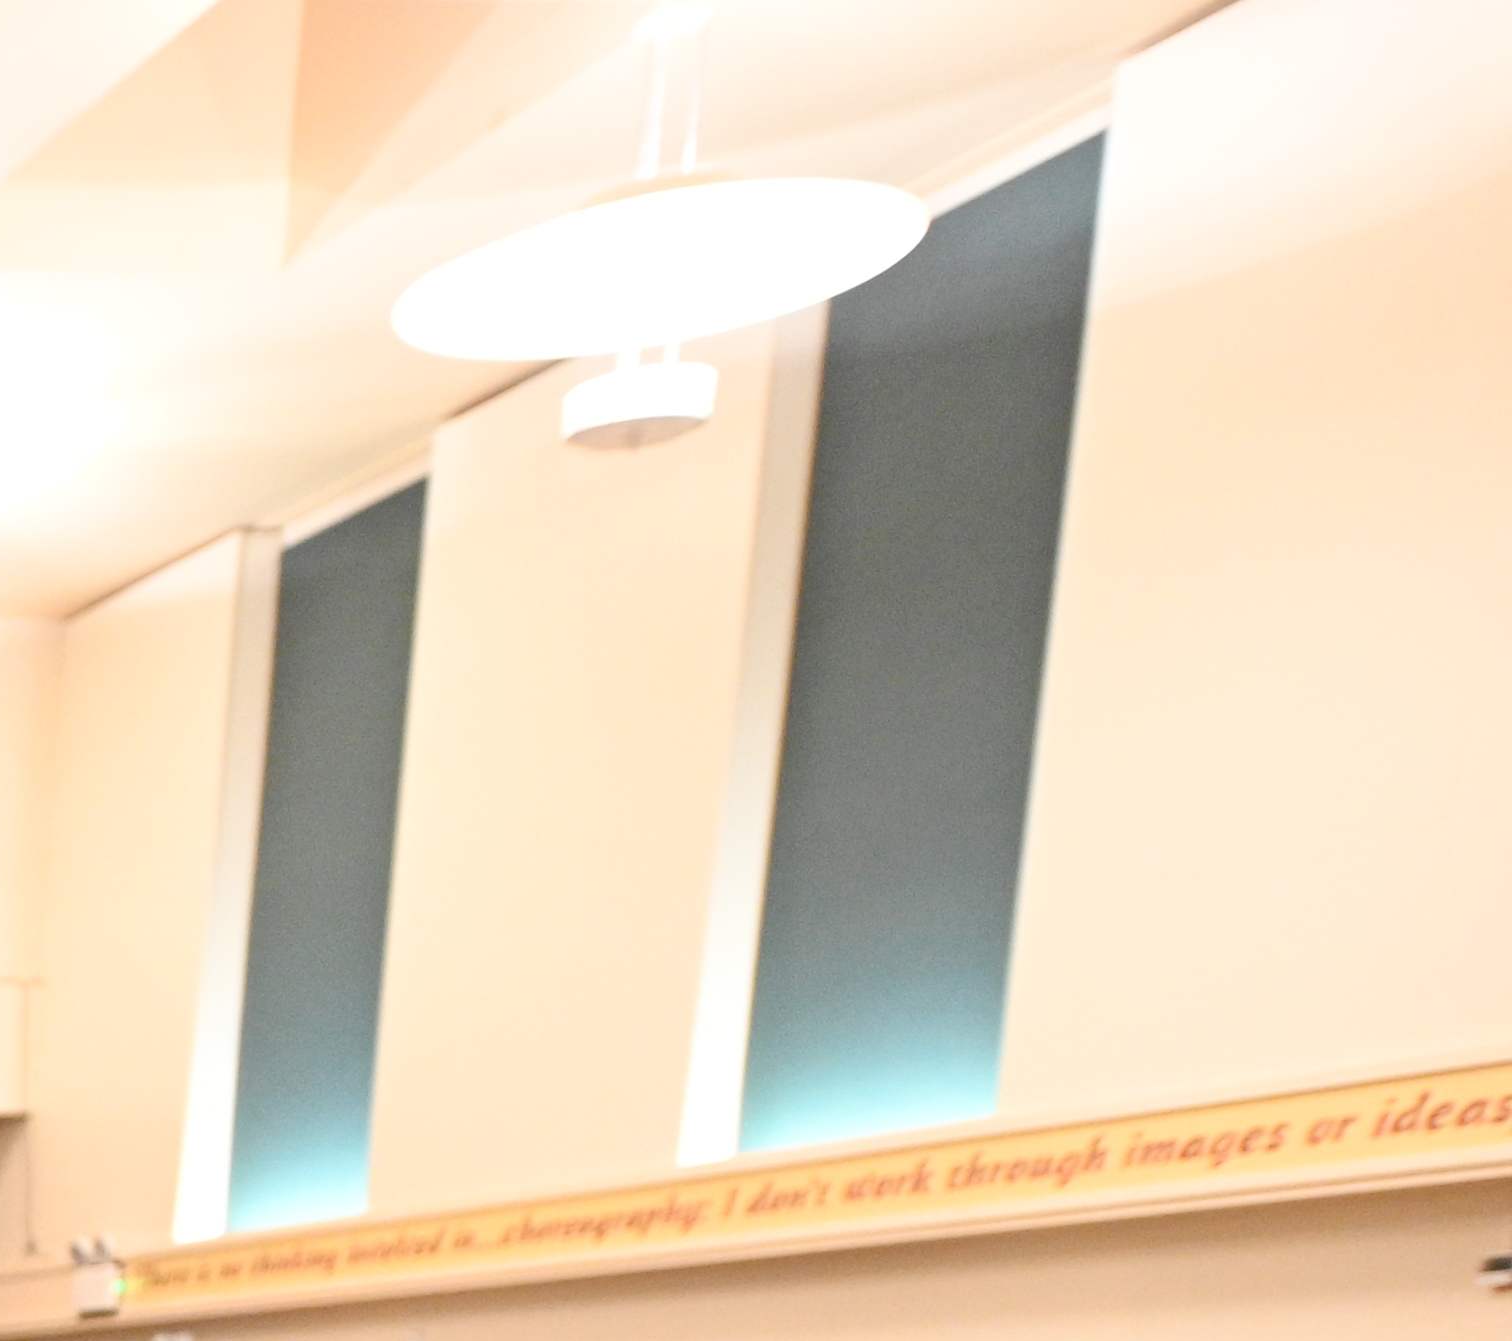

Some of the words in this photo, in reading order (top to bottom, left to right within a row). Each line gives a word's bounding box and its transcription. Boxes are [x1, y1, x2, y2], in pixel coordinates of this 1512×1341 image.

[746, 1177, 830, 1215] don't
[844, 1160, 932, 1202] work
[946, 1133, 1107, 1189] through
[1122, 1119, 1290, 1168] images
[1305, 1112, 1359, 1147] or
